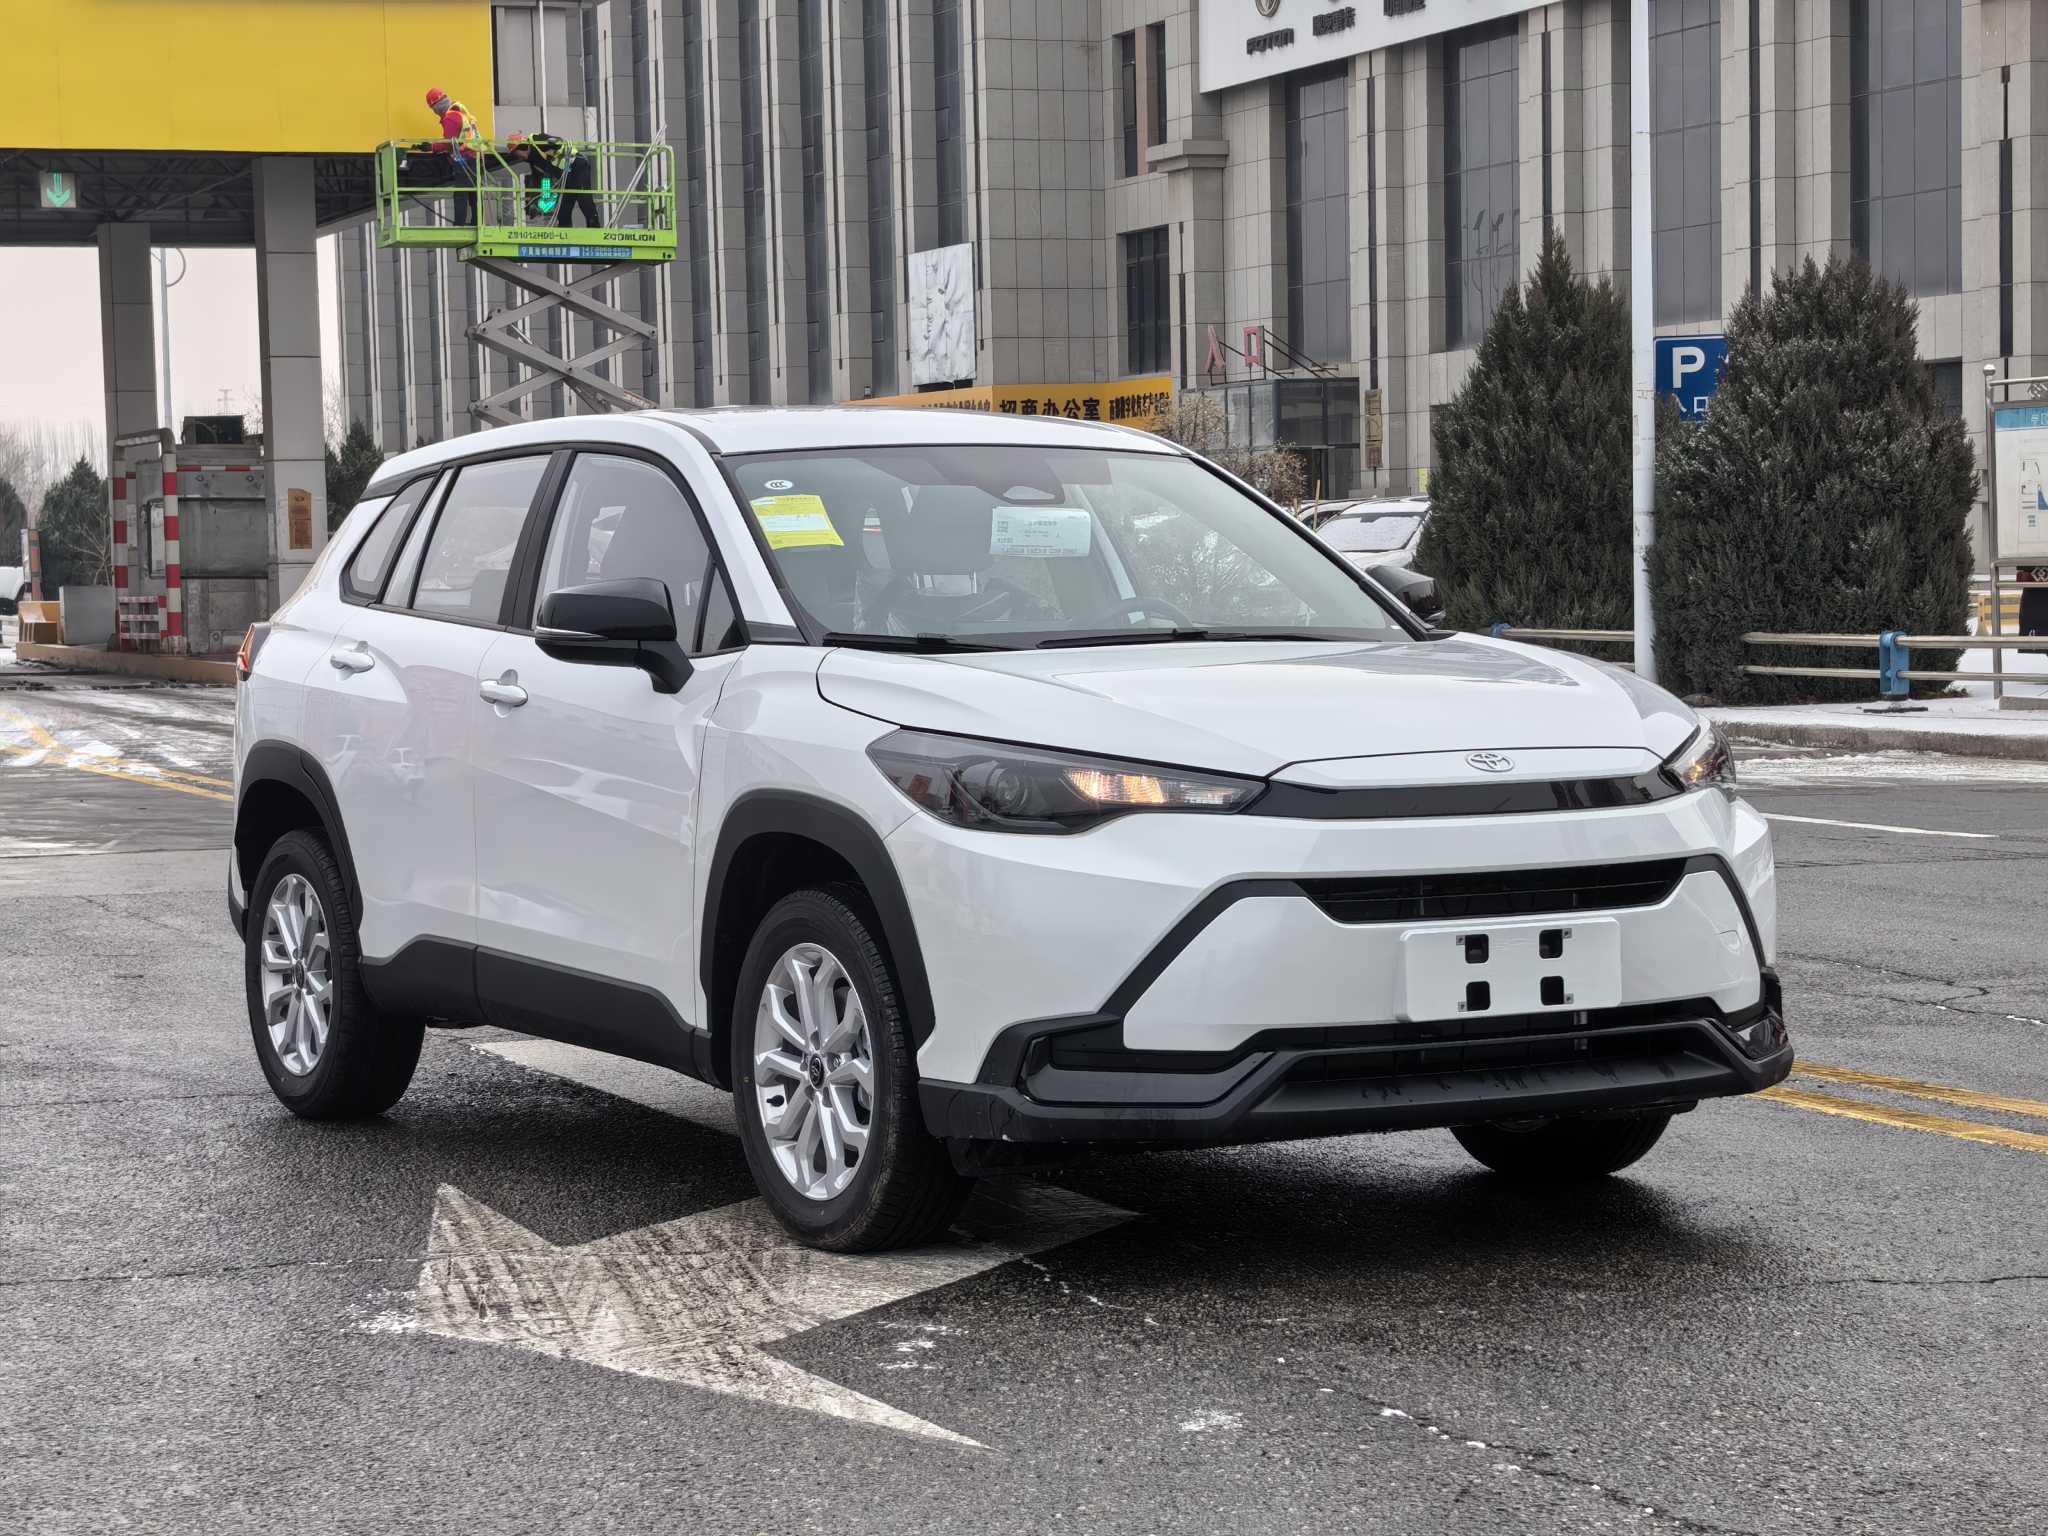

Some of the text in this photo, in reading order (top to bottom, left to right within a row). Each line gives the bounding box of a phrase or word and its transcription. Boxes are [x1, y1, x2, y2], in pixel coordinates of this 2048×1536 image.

[1672, 346, 1705, 389] P
[999, 397, 1101, 421] 招商办公室
